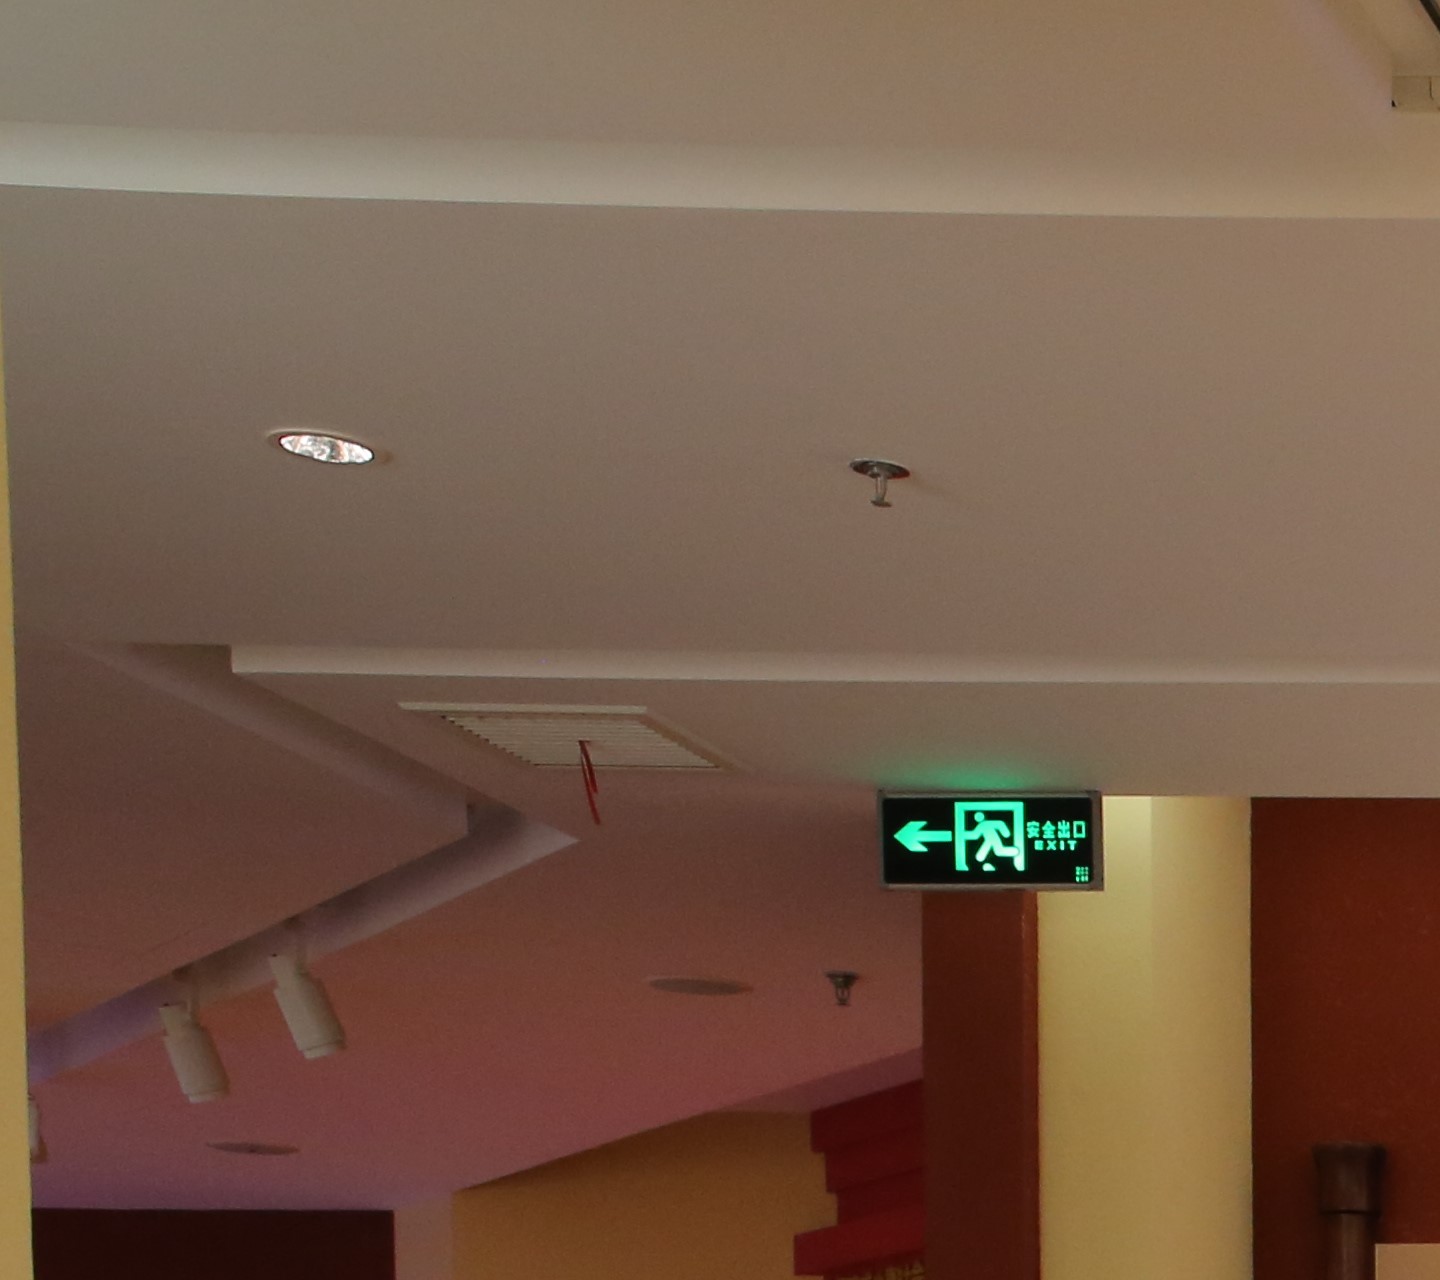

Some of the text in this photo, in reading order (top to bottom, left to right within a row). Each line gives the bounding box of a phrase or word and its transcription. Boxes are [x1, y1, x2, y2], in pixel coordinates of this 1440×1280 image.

[1026, 819, 1087, 839] 安全出口
[1034, 840, 1078, 851] EXIT
